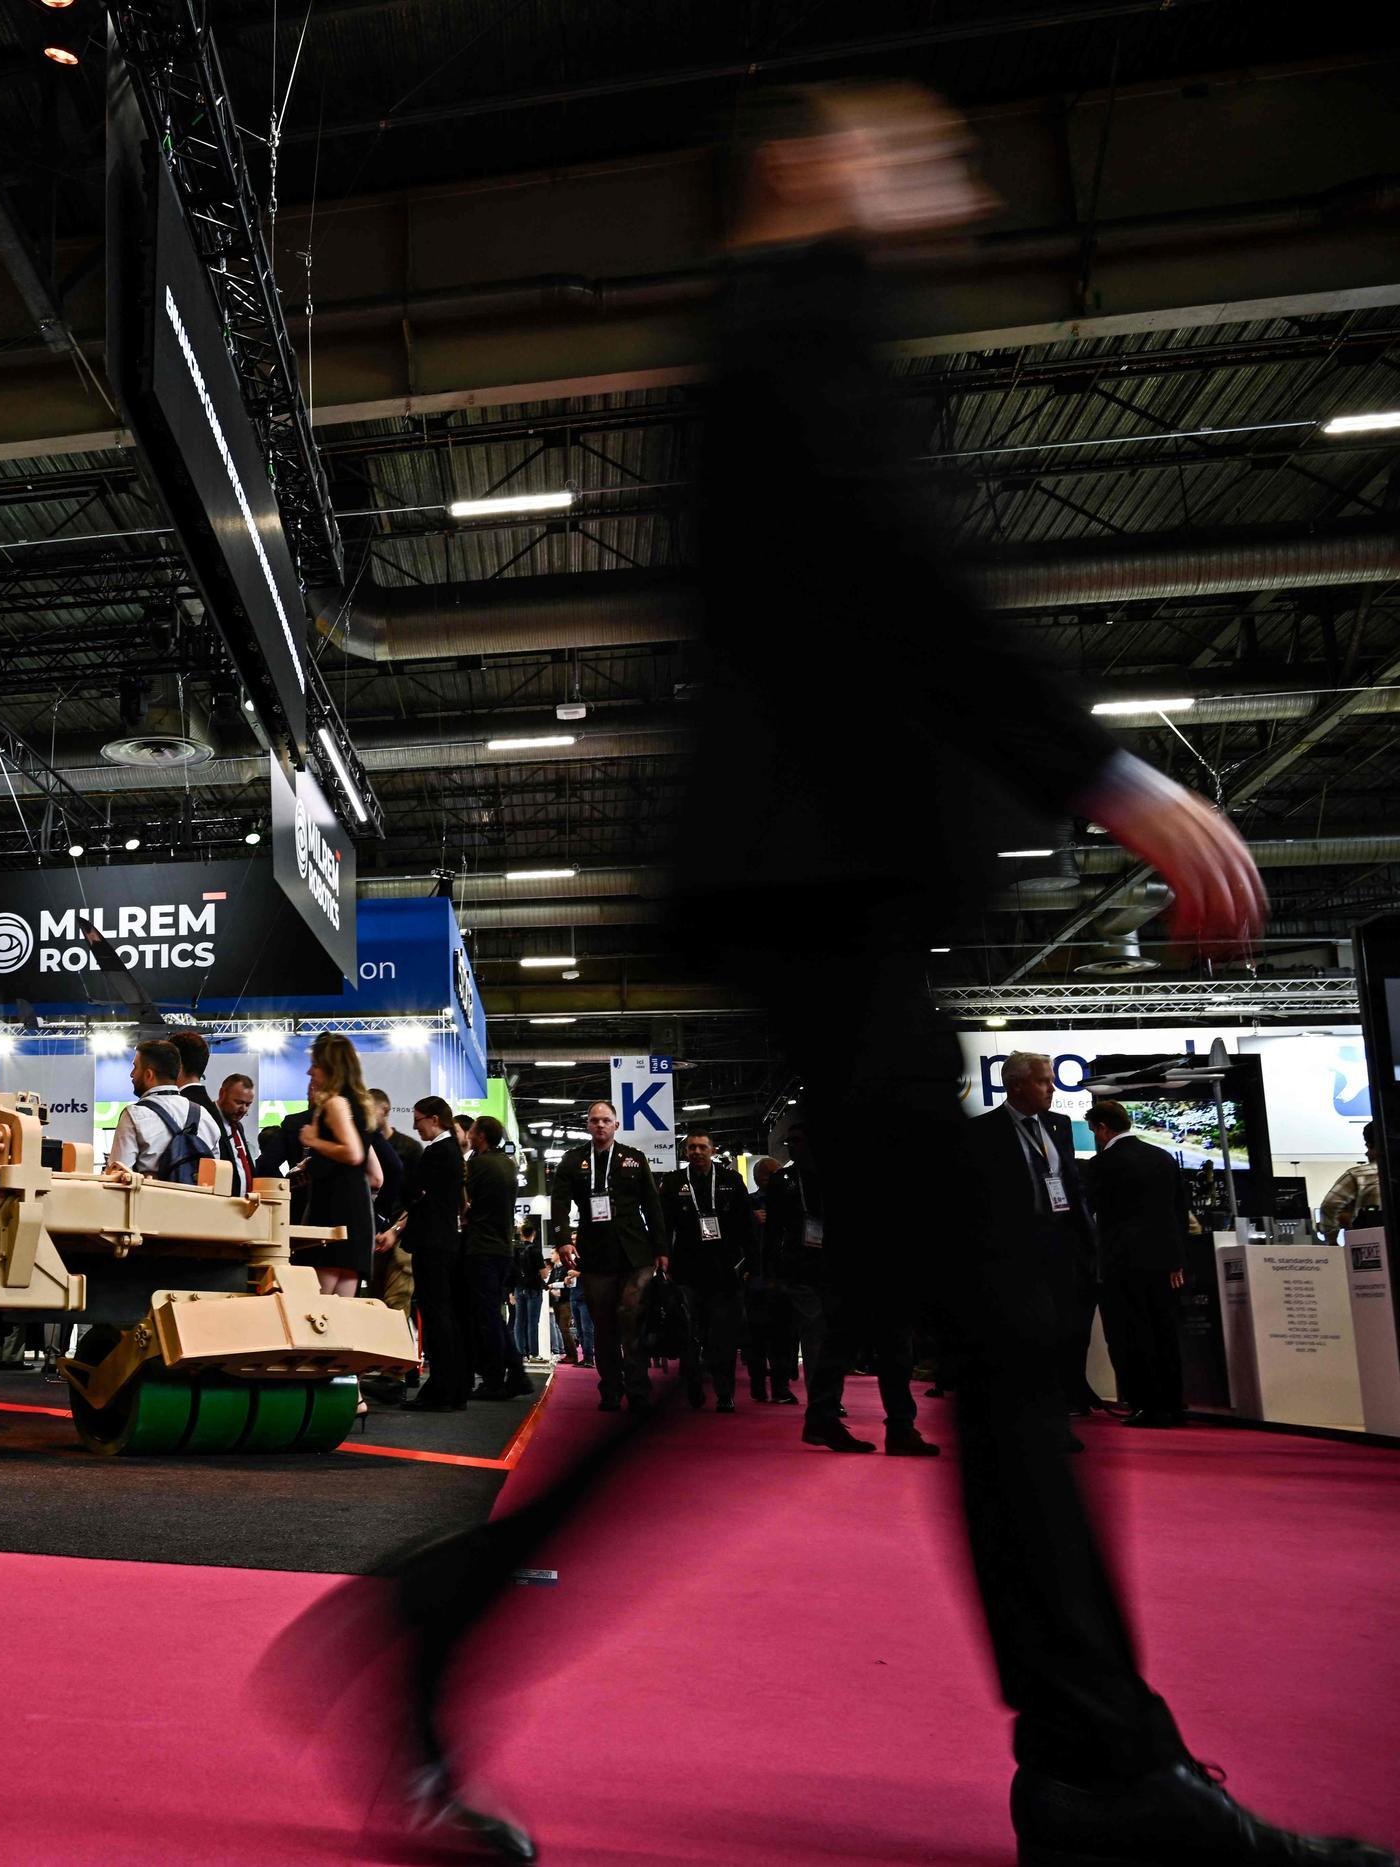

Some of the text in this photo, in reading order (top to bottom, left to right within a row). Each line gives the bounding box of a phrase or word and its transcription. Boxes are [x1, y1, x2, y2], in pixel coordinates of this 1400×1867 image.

[307, 814, 340, 896] MILREM
[308, 862, 340, 931] ROBOTICS
[660, 1060, 669, 1070] 6
[621, 1082, 670, 1131] K
